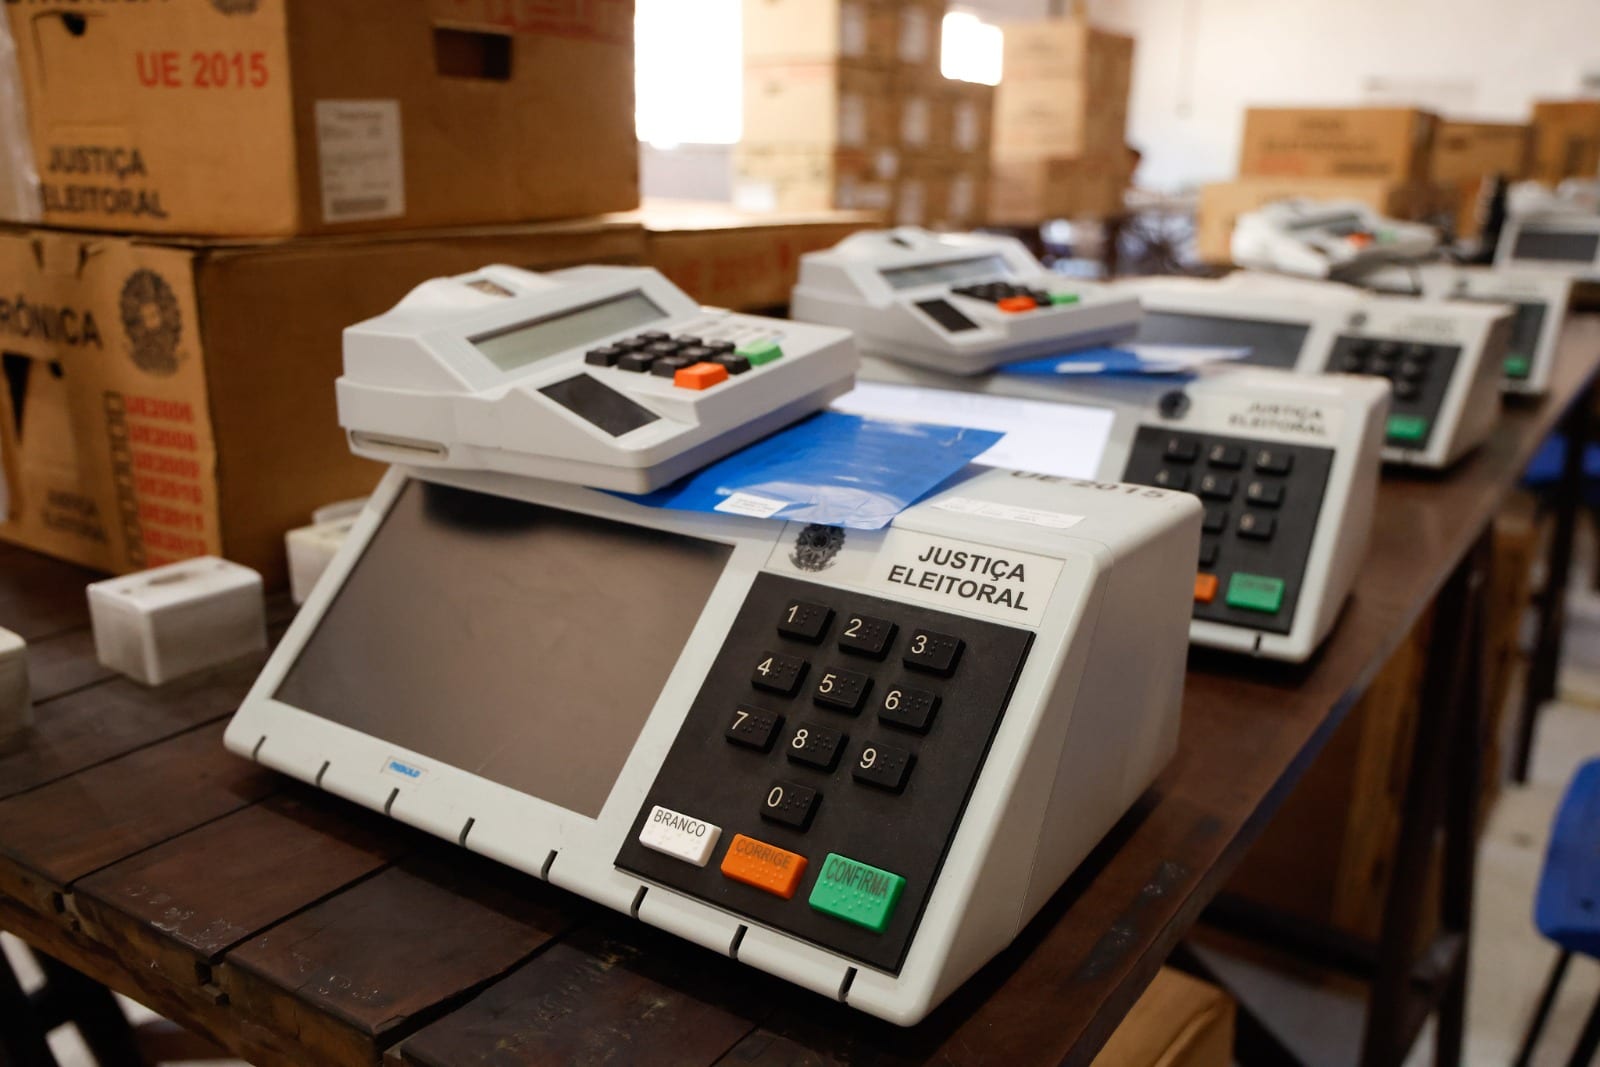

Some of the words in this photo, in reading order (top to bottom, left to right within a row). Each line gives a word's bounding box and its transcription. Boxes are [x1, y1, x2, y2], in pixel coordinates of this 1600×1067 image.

[136, 51, 182, 88] UE
[193, 51, 269, 88] 2015
[48, 146, 147, 181] JUSTIÇA
[40, 183, 169, 219] ELEITORAL
[1229, 413, 1327, 435] ELEITORAL
[1249, 402, 1323, 419] JUSTIÇA
[1073, 480, 1167, 499] 2015
[918, 546, 1025, 582] JUSTIÇA
[887, 564, 1028, 611] ELEITORAL
[788, 605, 799, 623] 1
[844, 618, 862, 638] 2
[911, 634, 928, 654] 3
[757, 657, 773, 676] 4
[819, 673, 837, 693] 5
[885, 690, 902, 710] 6
[731, 710, 749, 730] 7
[791, 728, 809, 749] 8
[859, 748, 877, 769] 9
[767, 786, 783, 808] 0
[653, 809, 706, 838] BRANCO
[735, 838, 792, 870] CORRIGE
[826, 859, 891, 898] CONFIRMA
